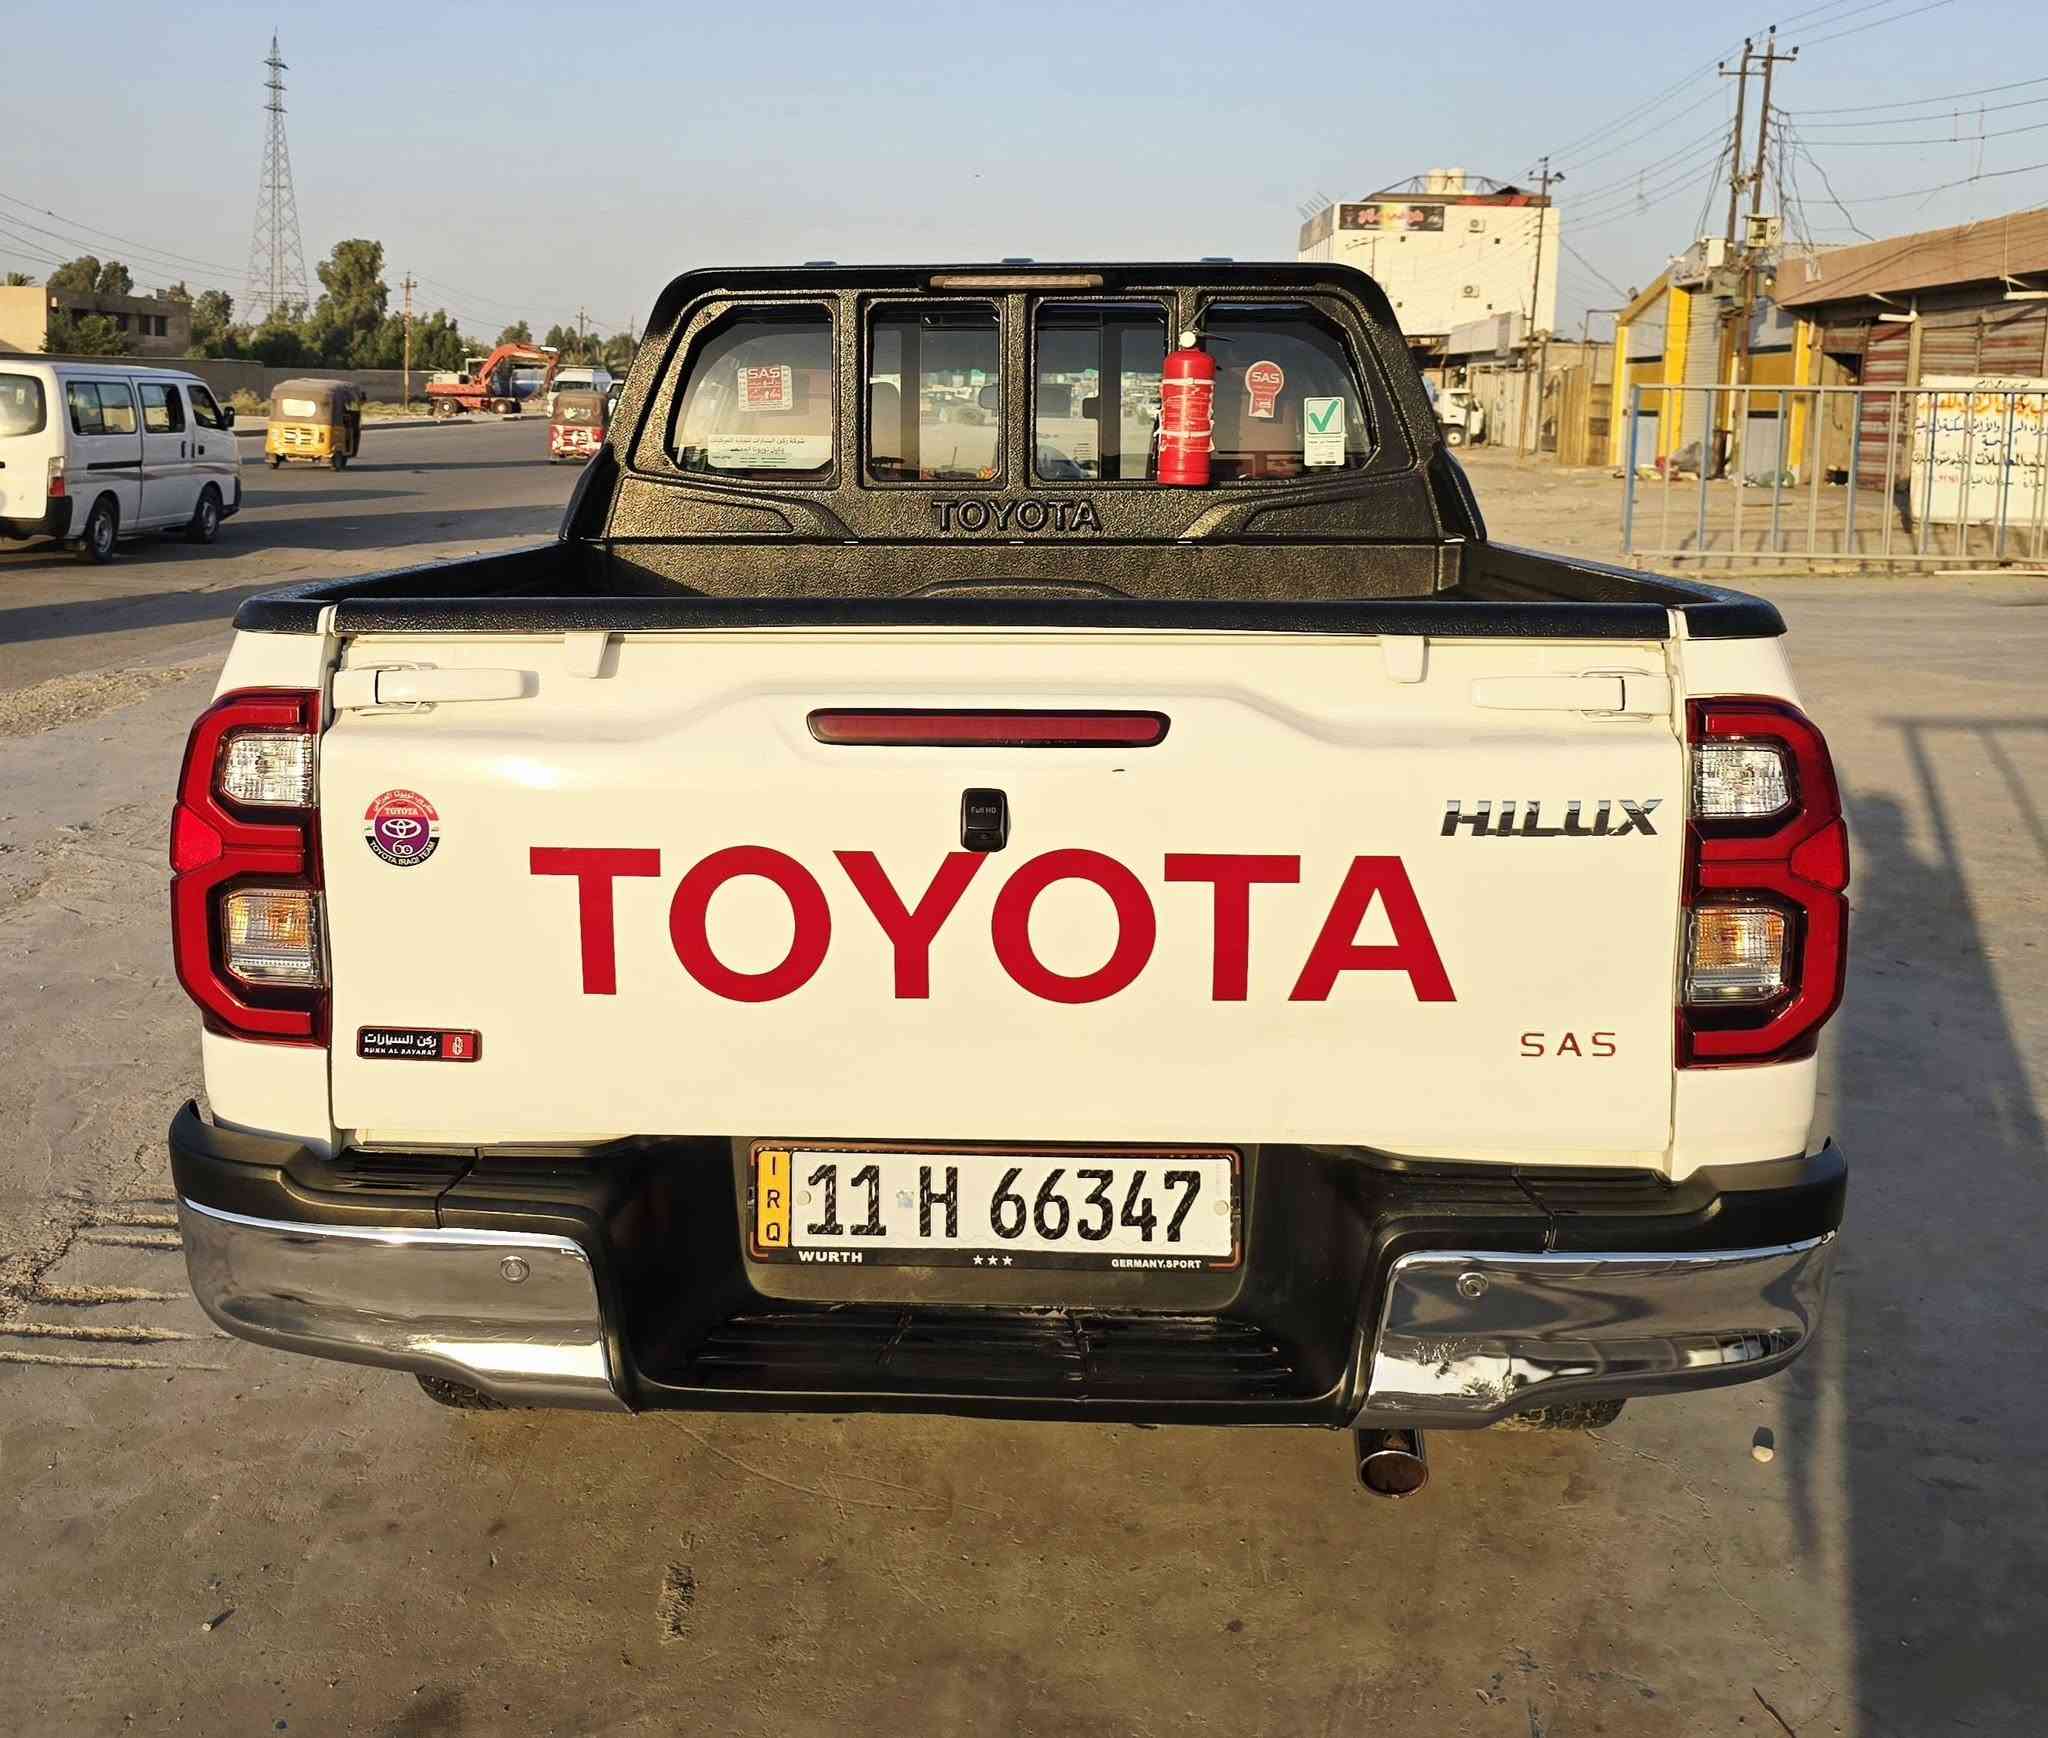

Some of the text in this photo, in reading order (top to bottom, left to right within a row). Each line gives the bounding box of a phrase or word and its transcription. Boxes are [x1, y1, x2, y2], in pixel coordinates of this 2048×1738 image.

[747, 367, 781, 379] SAS
[1251, 371, 1281, 384] SAS
[931, 500, 1103, 533] TOYOTA
[1441, 799, 1663, 837] HILUX
[370, 841, 397, 864] TOYOTA
[419, 841, 436, 860] TEAM
[529, 845, 1457, 1003] TOYOTA
[364, 1033, 437, 1048] ركن السيارات
[1520, 1032, 1616, 1057] SAS
[765, 1156, 782, 1242] IRQ
[806, 1164, 1202, 1243] 11 H 66347
[798, 1250, 863, 1263] WURTH
